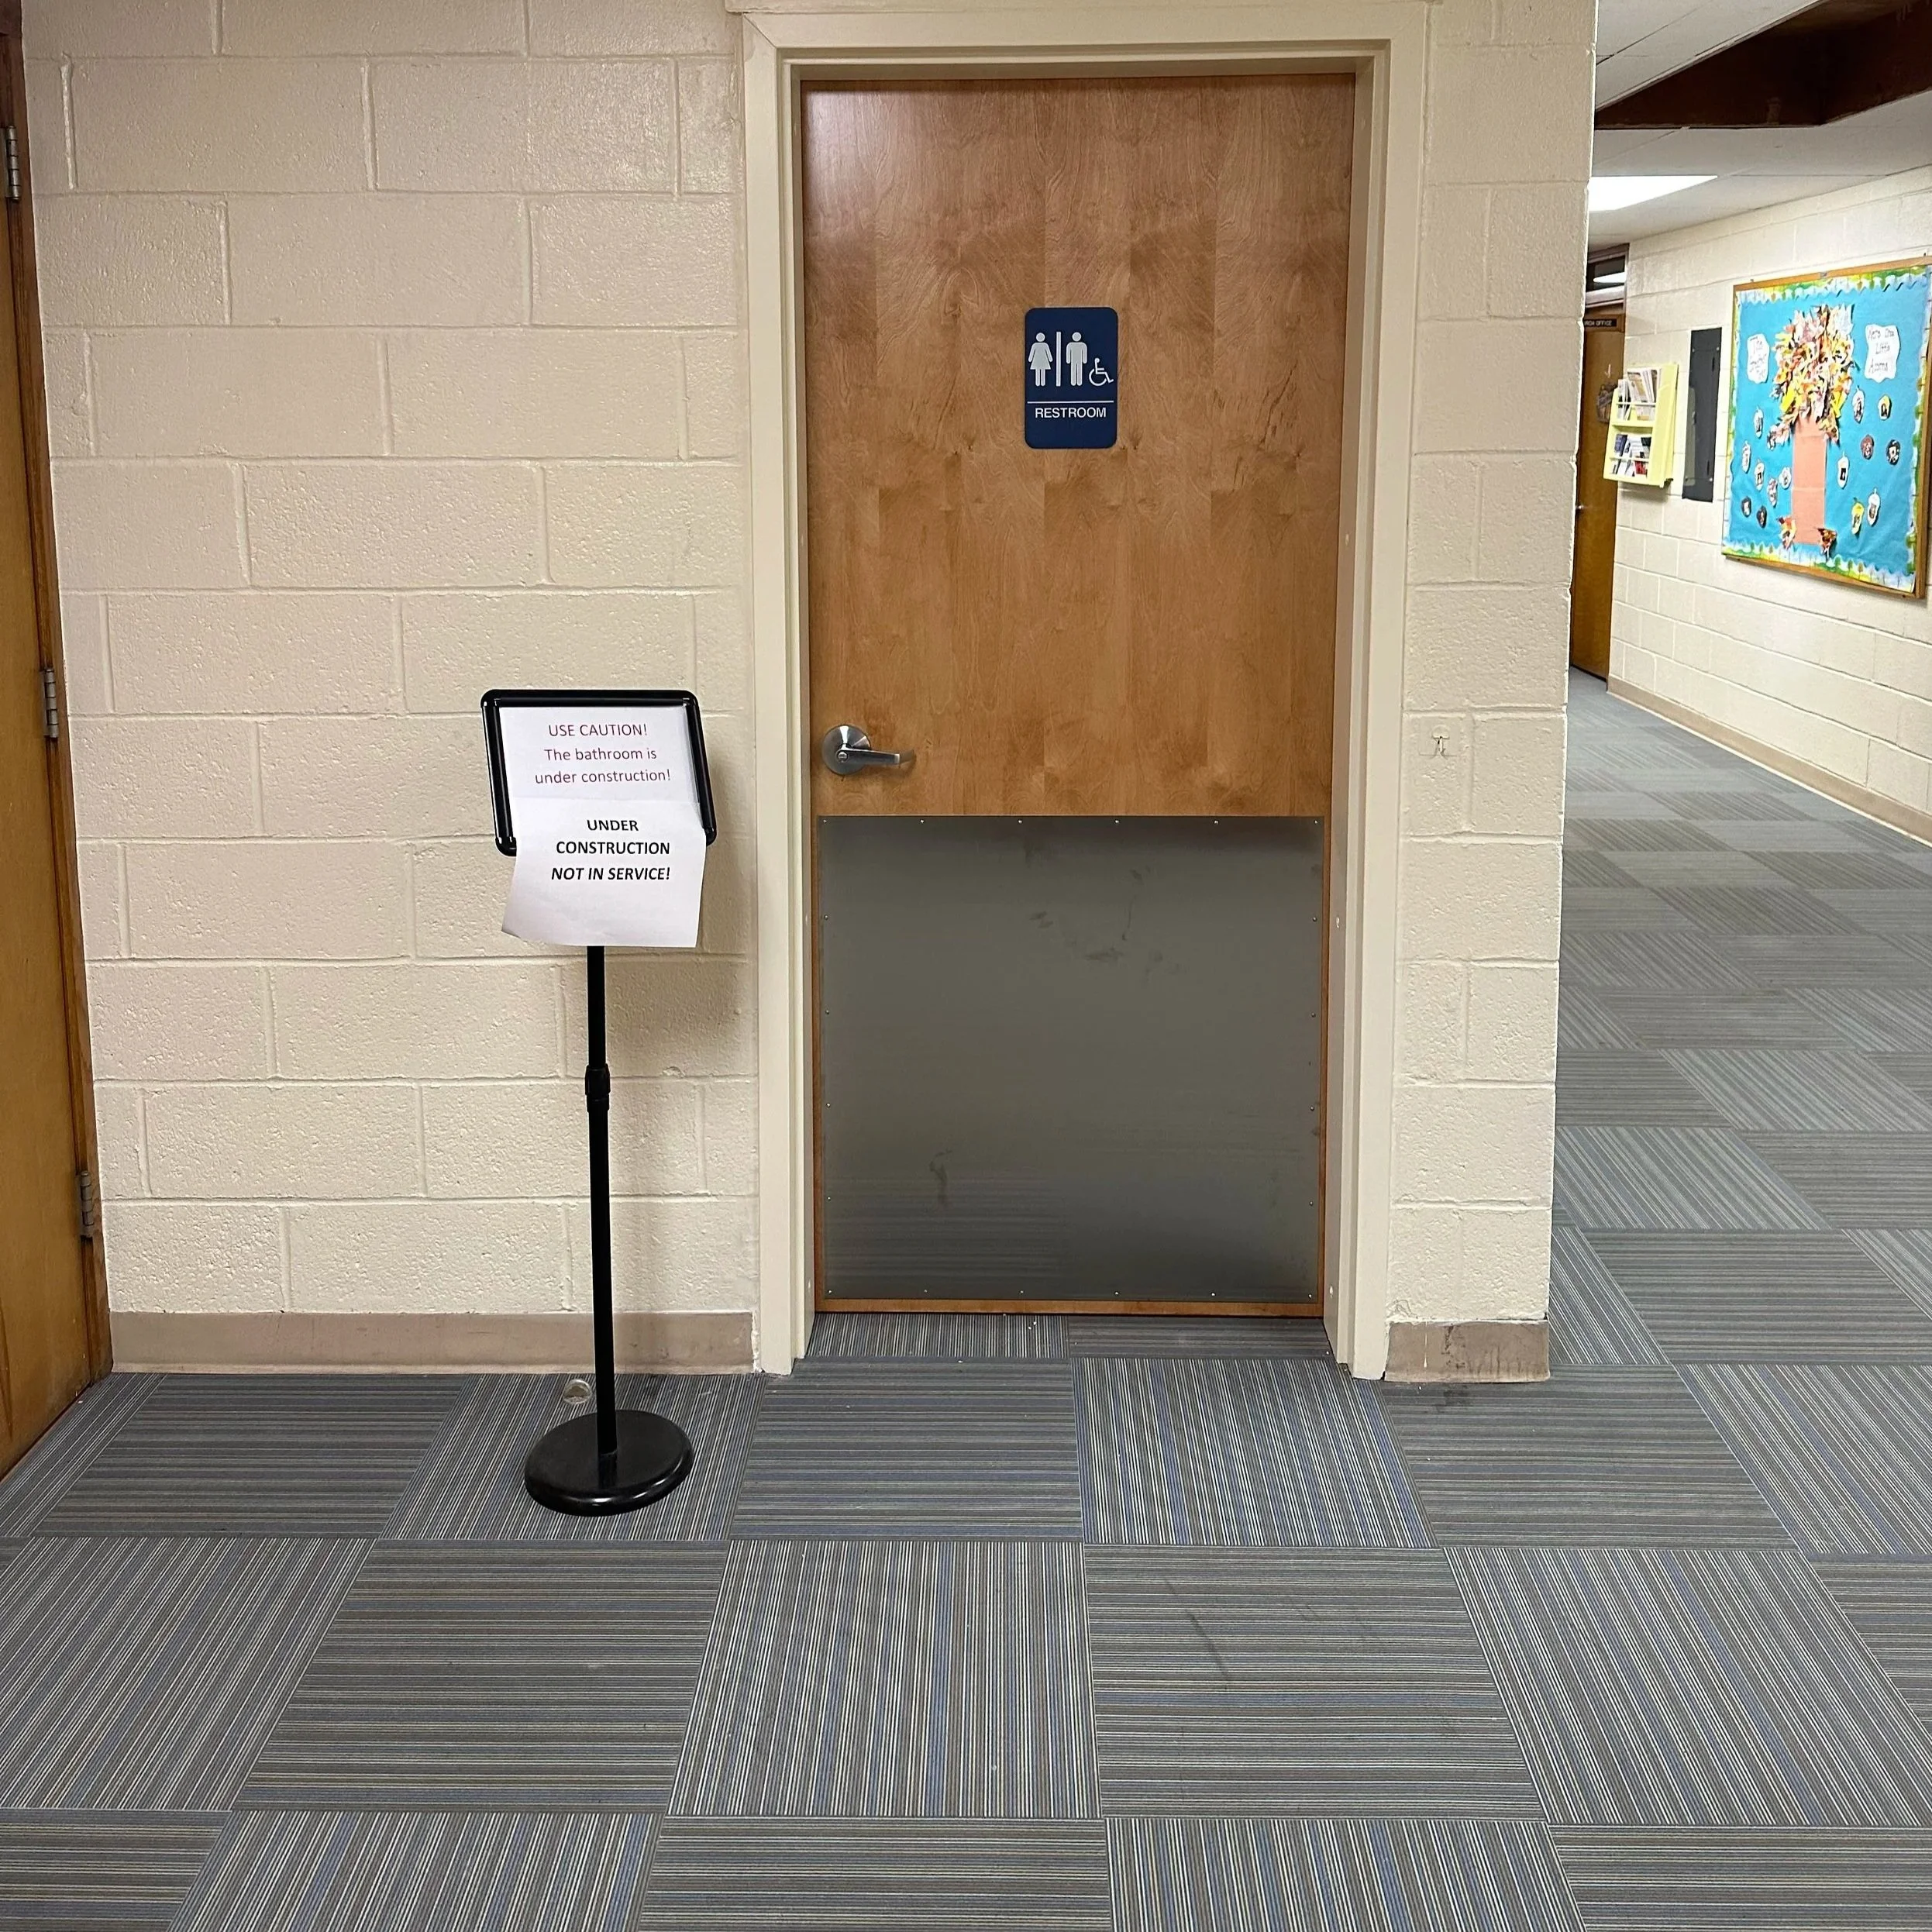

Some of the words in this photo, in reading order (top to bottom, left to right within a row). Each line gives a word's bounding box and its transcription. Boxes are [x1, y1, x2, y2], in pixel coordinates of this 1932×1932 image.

[1035, 407, 1107, 418] RESTROOM
[548, 724, 576, 737] USE
[579, 723, 648, 736] CAUTION!
[543, 749, 571, 761] The
[575, 747, 643, 761] bathroom
[647, 747, 657, 760] is
[535, 771, 577, 784] under
[581, 769, 671, 783] construction!
[587, 819, 639, 832] UNDER
[556, 842, 670, 855] CONSTRUCTION
[551, 867, 585, 880] NOT
[587, 867, 604, 880] IN
[608, 867, 670, 880] SERVICE!
